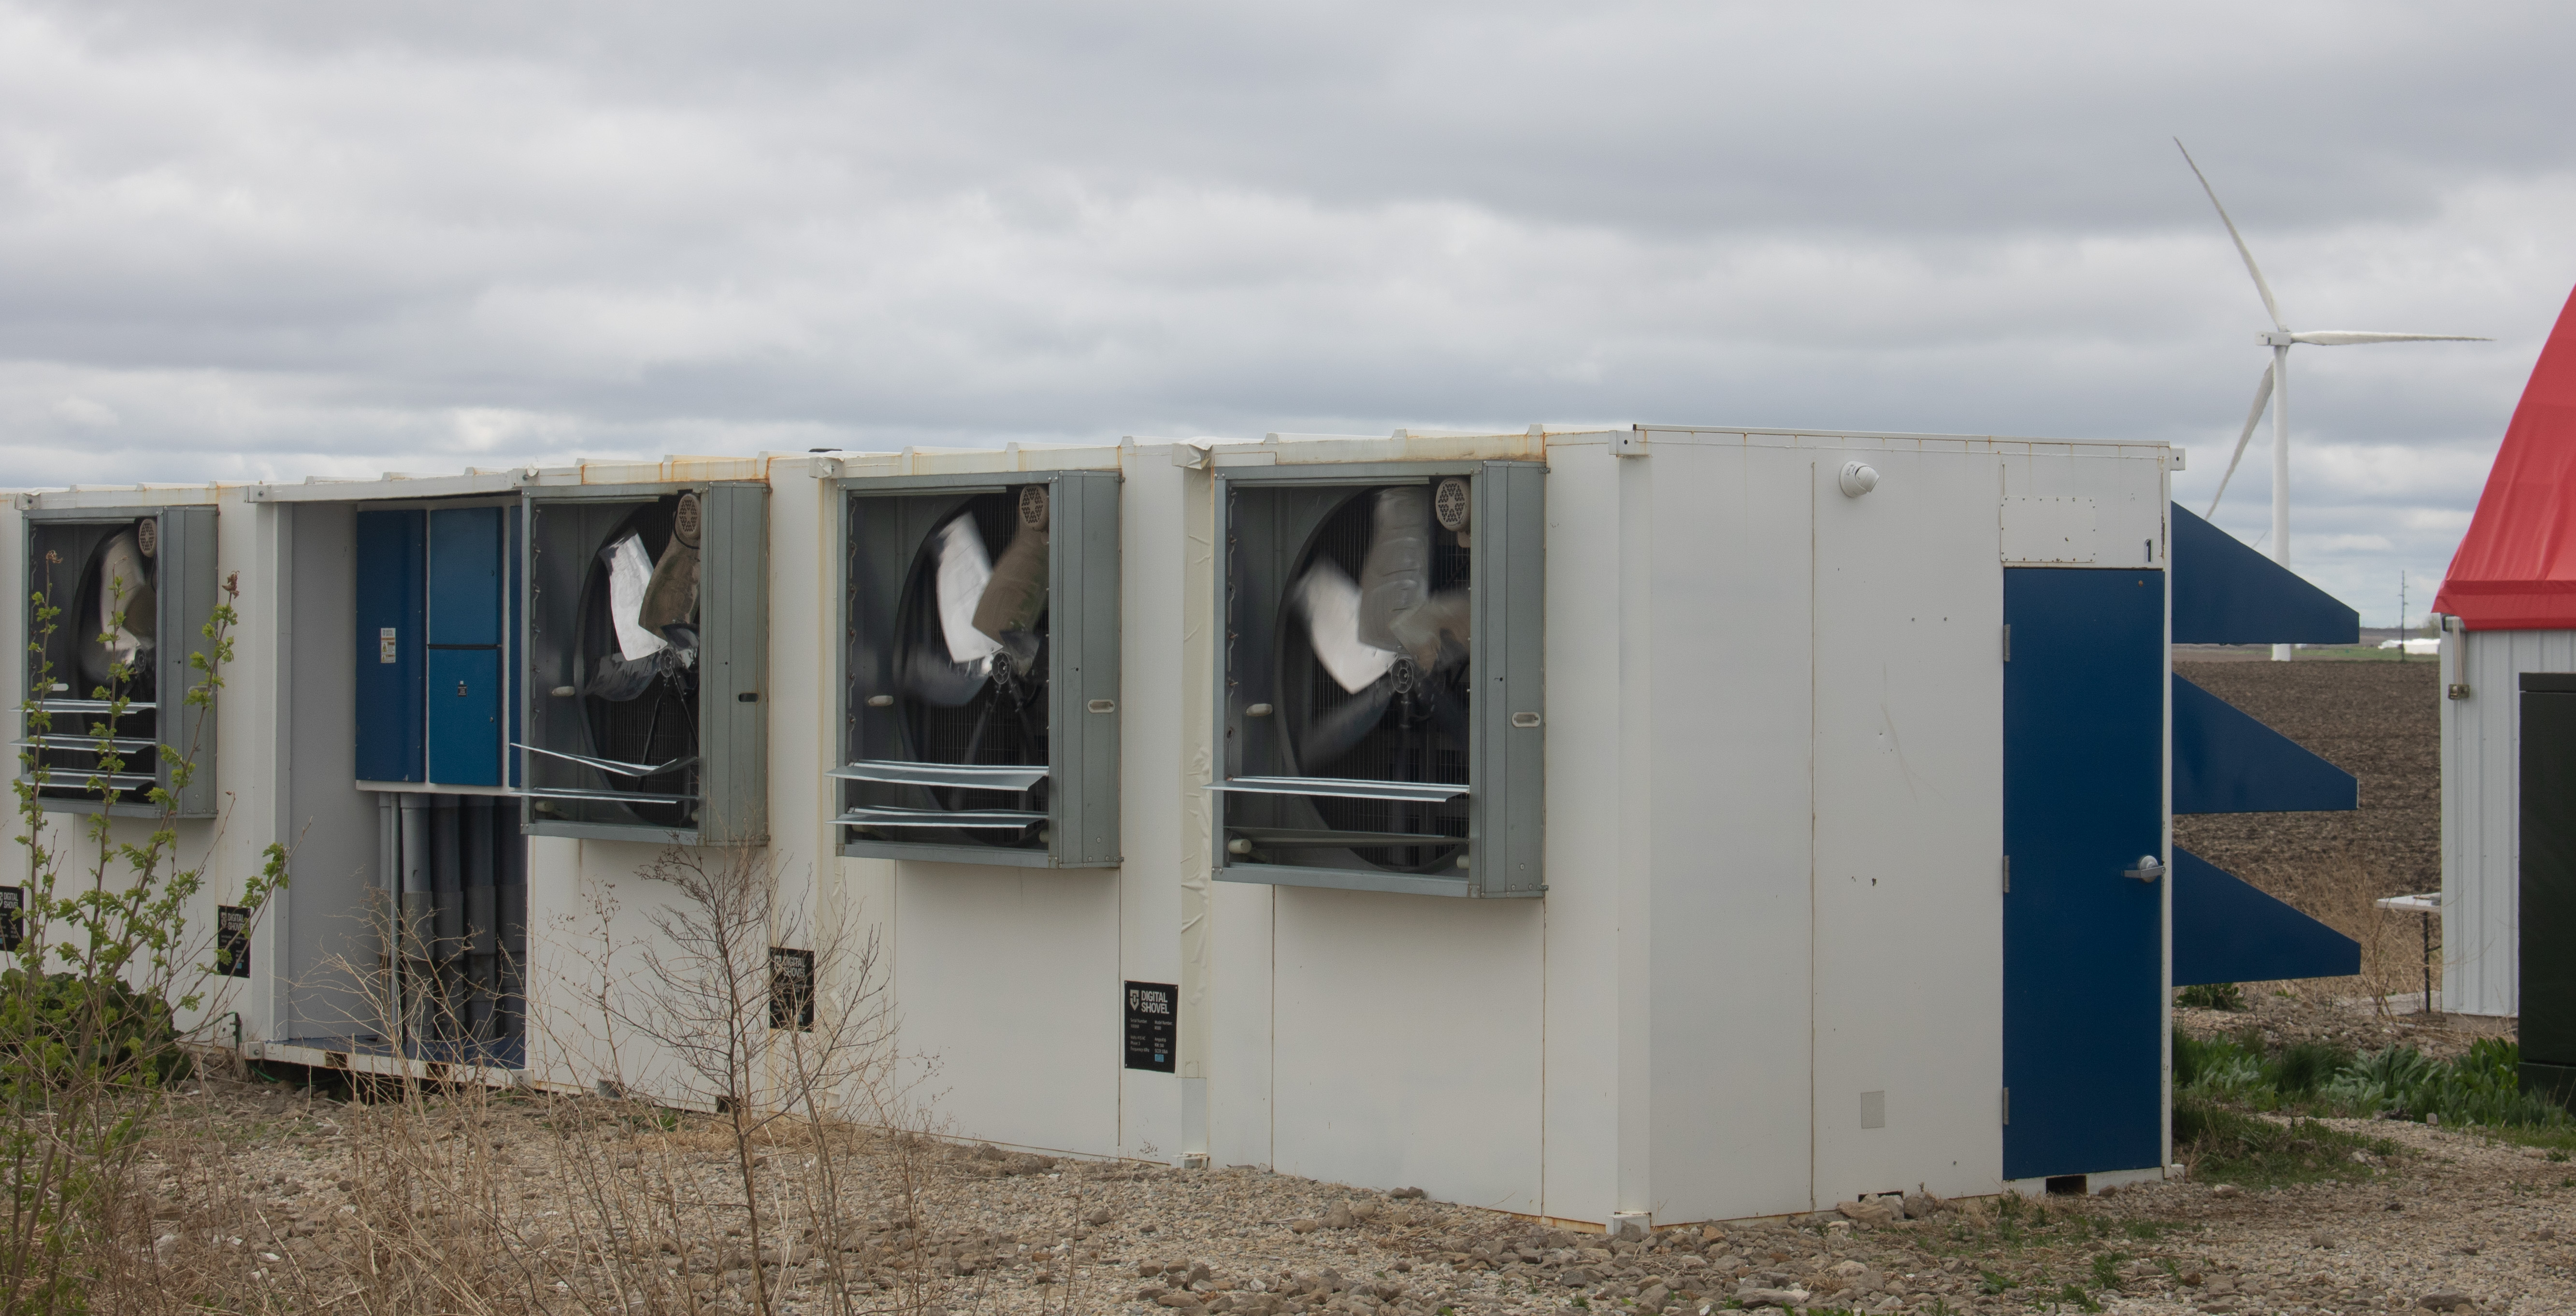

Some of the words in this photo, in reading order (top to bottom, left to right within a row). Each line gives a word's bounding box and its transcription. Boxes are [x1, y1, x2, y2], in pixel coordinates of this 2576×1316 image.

[2145, 539, 2152, 562] 1
[4, 892, 18, 901] DIGITAL
[228, 913, 244, 922] DIGITAL
[1141, 990, 1167, 1002] DIGITAL
[1141, 1001, 1169, 1014] SHOVEL
